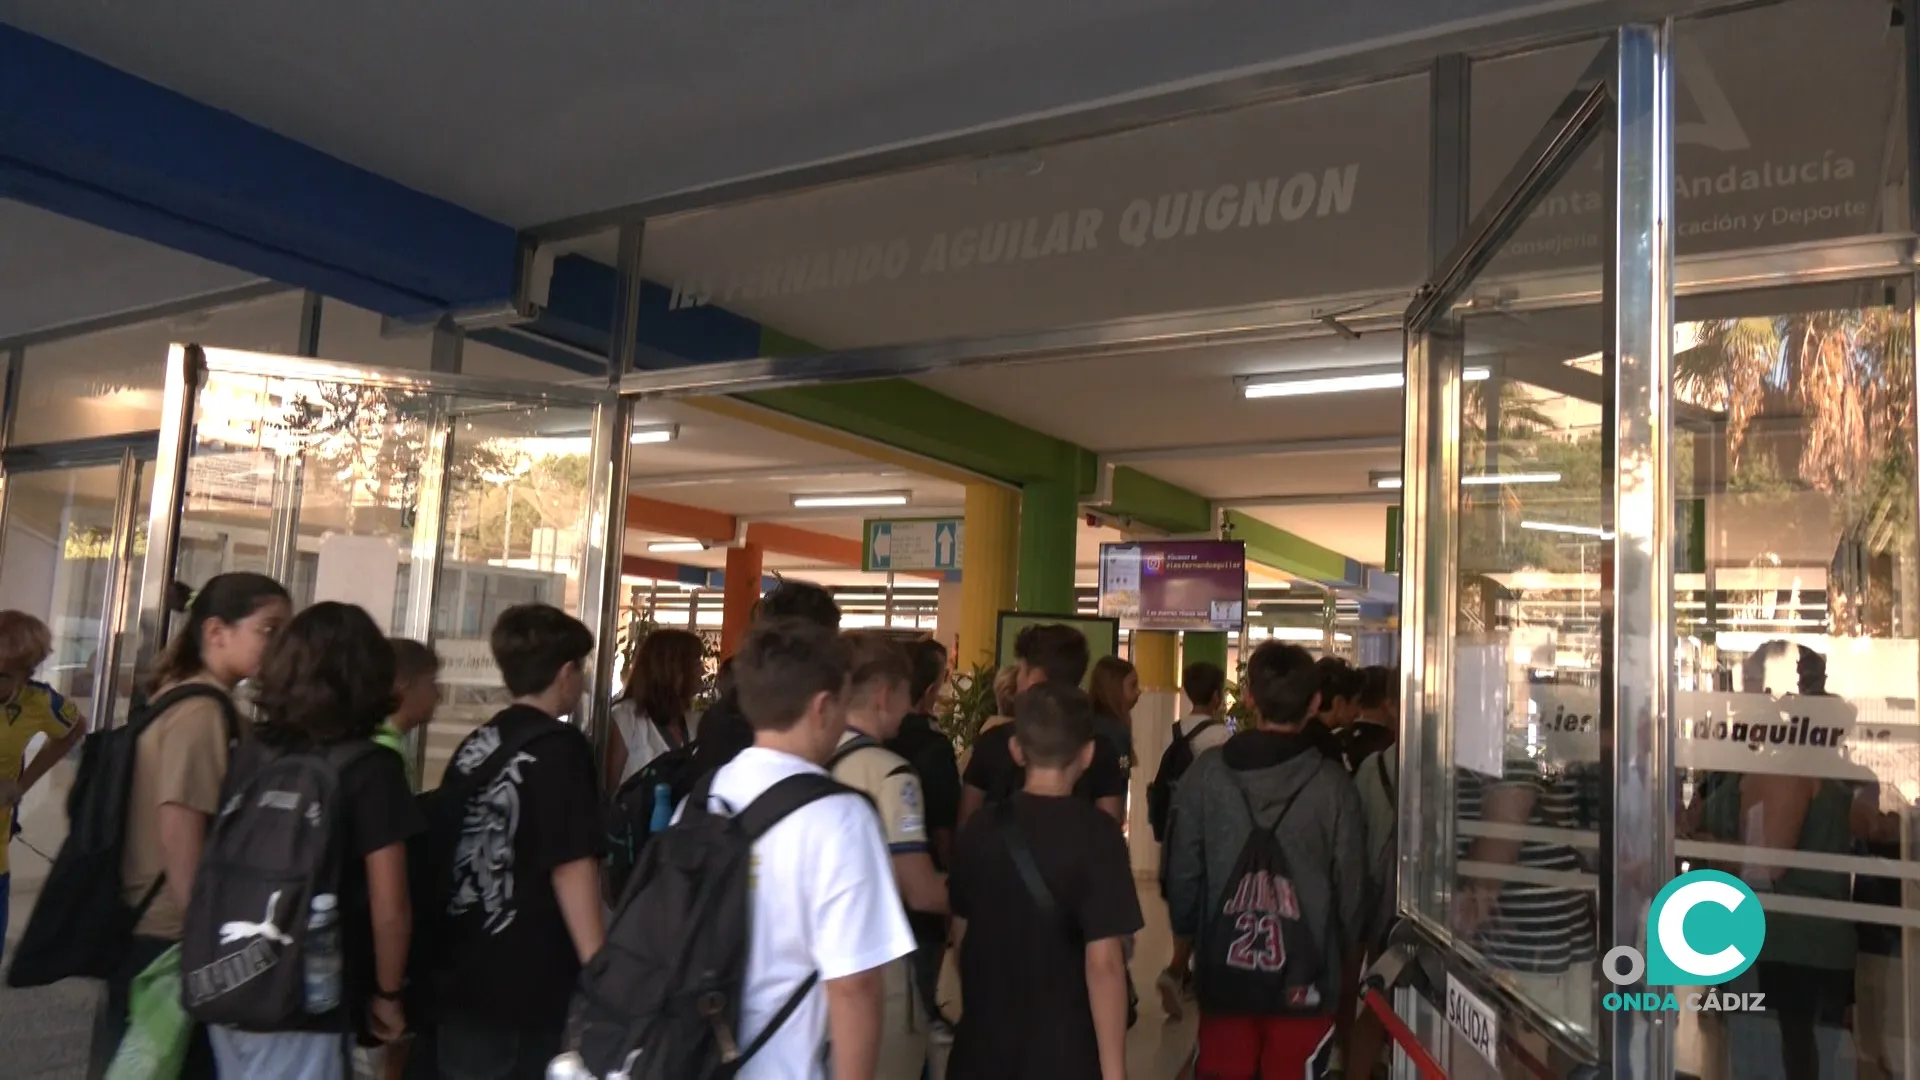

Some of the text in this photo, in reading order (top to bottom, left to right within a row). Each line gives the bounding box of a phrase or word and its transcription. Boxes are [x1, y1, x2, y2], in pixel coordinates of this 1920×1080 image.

[919, 208, 1103, 276] AGUILAR
[1118, 162, 1360, 248] QUIGNON
[1752, 211, 1766, 232] y
[1771, 198, 1867, 229] Deporte
[1226, 911, 1286, 973] 23
[1449, 988, 1490, 1054] SALIDA
